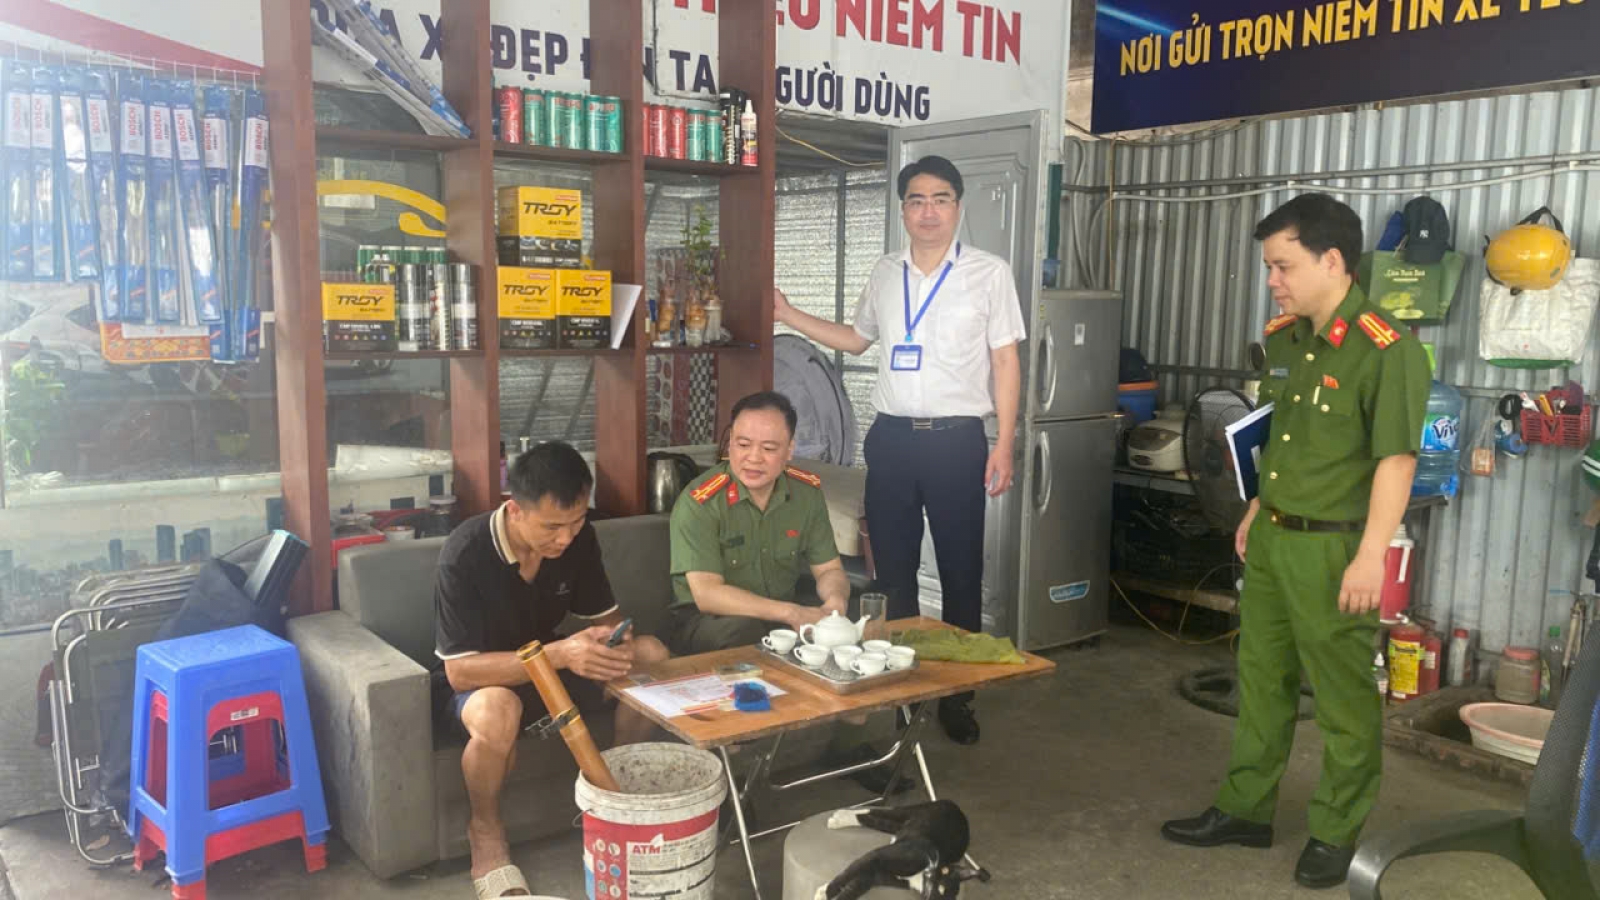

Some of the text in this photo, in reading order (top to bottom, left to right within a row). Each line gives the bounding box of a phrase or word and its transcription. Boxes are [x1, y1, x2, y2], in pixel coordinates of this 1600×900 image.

[957, 1, 1021, 66] TIN
[1119, 33, 1162, 77] NƠI
[1168, 12, 1211, 69] GỬI
[1219, 9, 1294, 61] TRỌN
[491, 24, 569, 81] ĐẸP
[775, 61, 844, 112] GƯỜI
[855, 71, 931, 121] DÙNG
[523, 201, 578, 217] TROY
[503, 284, 549, 296] TROY
[561, 286, 604, 297] TROY
[336, 295, 384, 306] TROY
[633, 845, 661, 854] ATM
